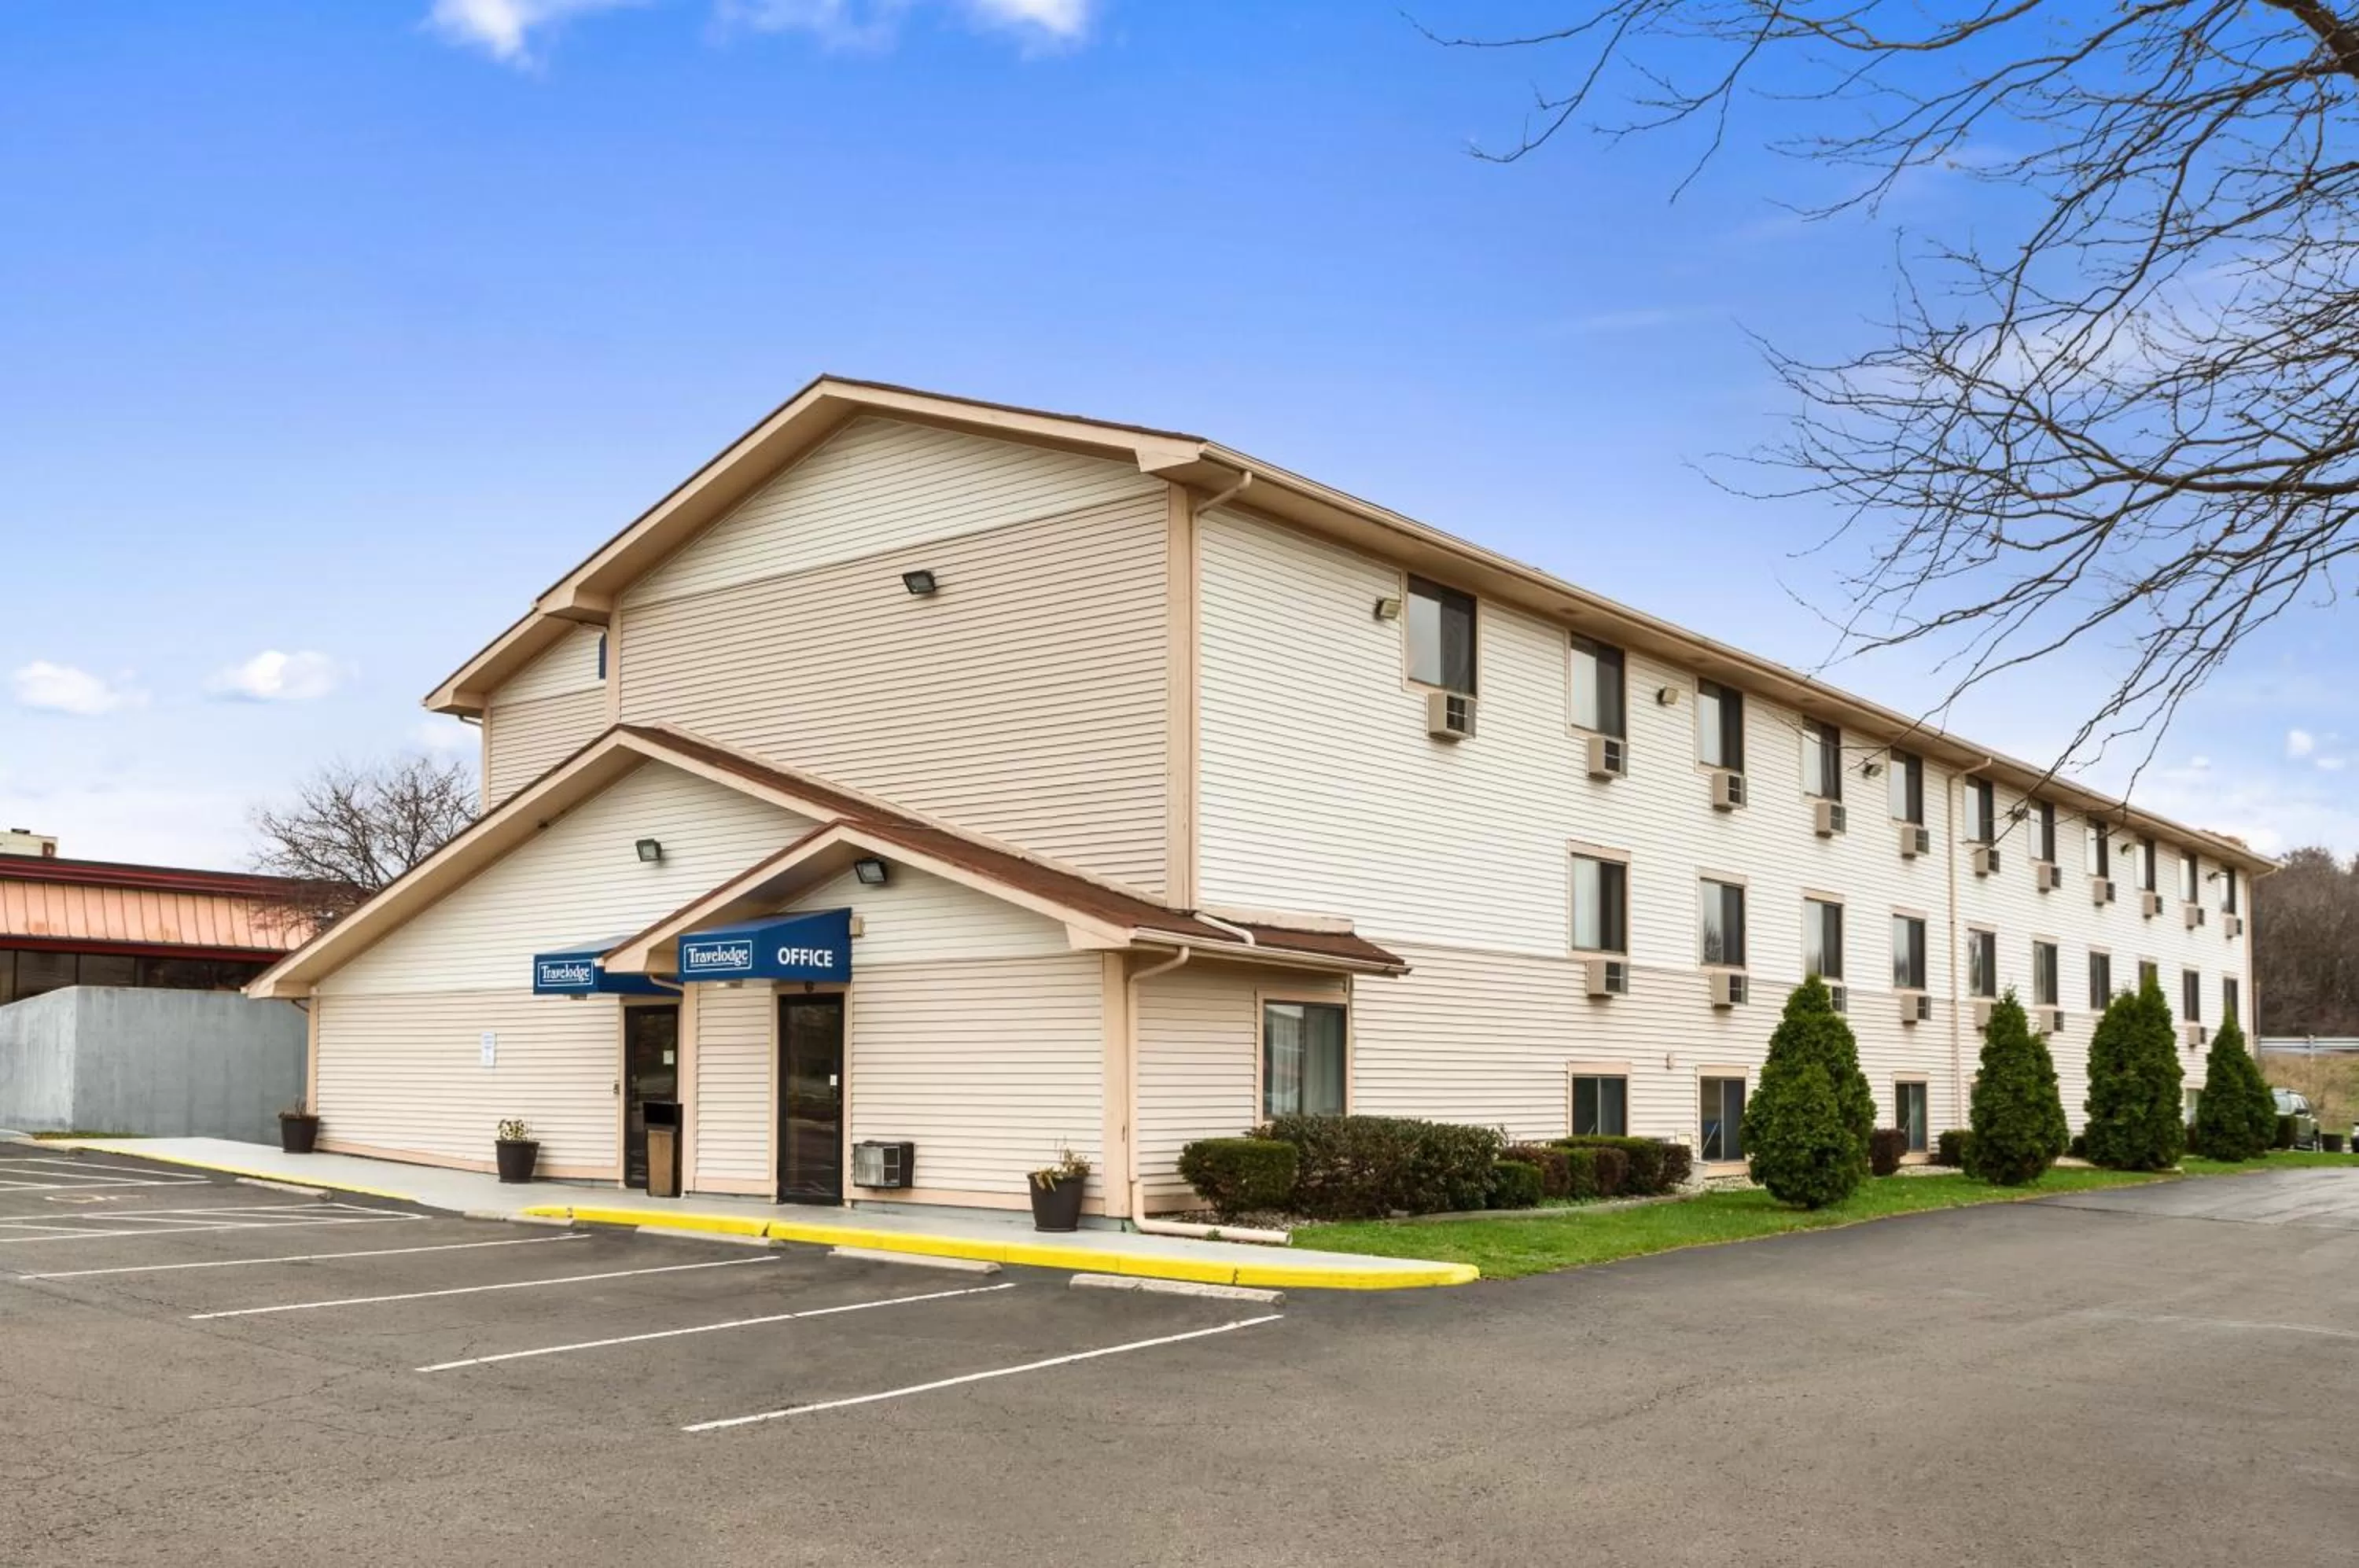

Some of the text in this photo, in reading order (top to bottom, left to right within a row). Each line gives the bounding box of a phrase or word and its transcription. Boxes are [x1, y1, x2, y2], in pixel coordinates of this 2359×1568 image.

[688, 945, 749, 966] Travelodge
[778, 947, 834, 967] OFFICE
[540, 963, 591, 982] Travelodge
